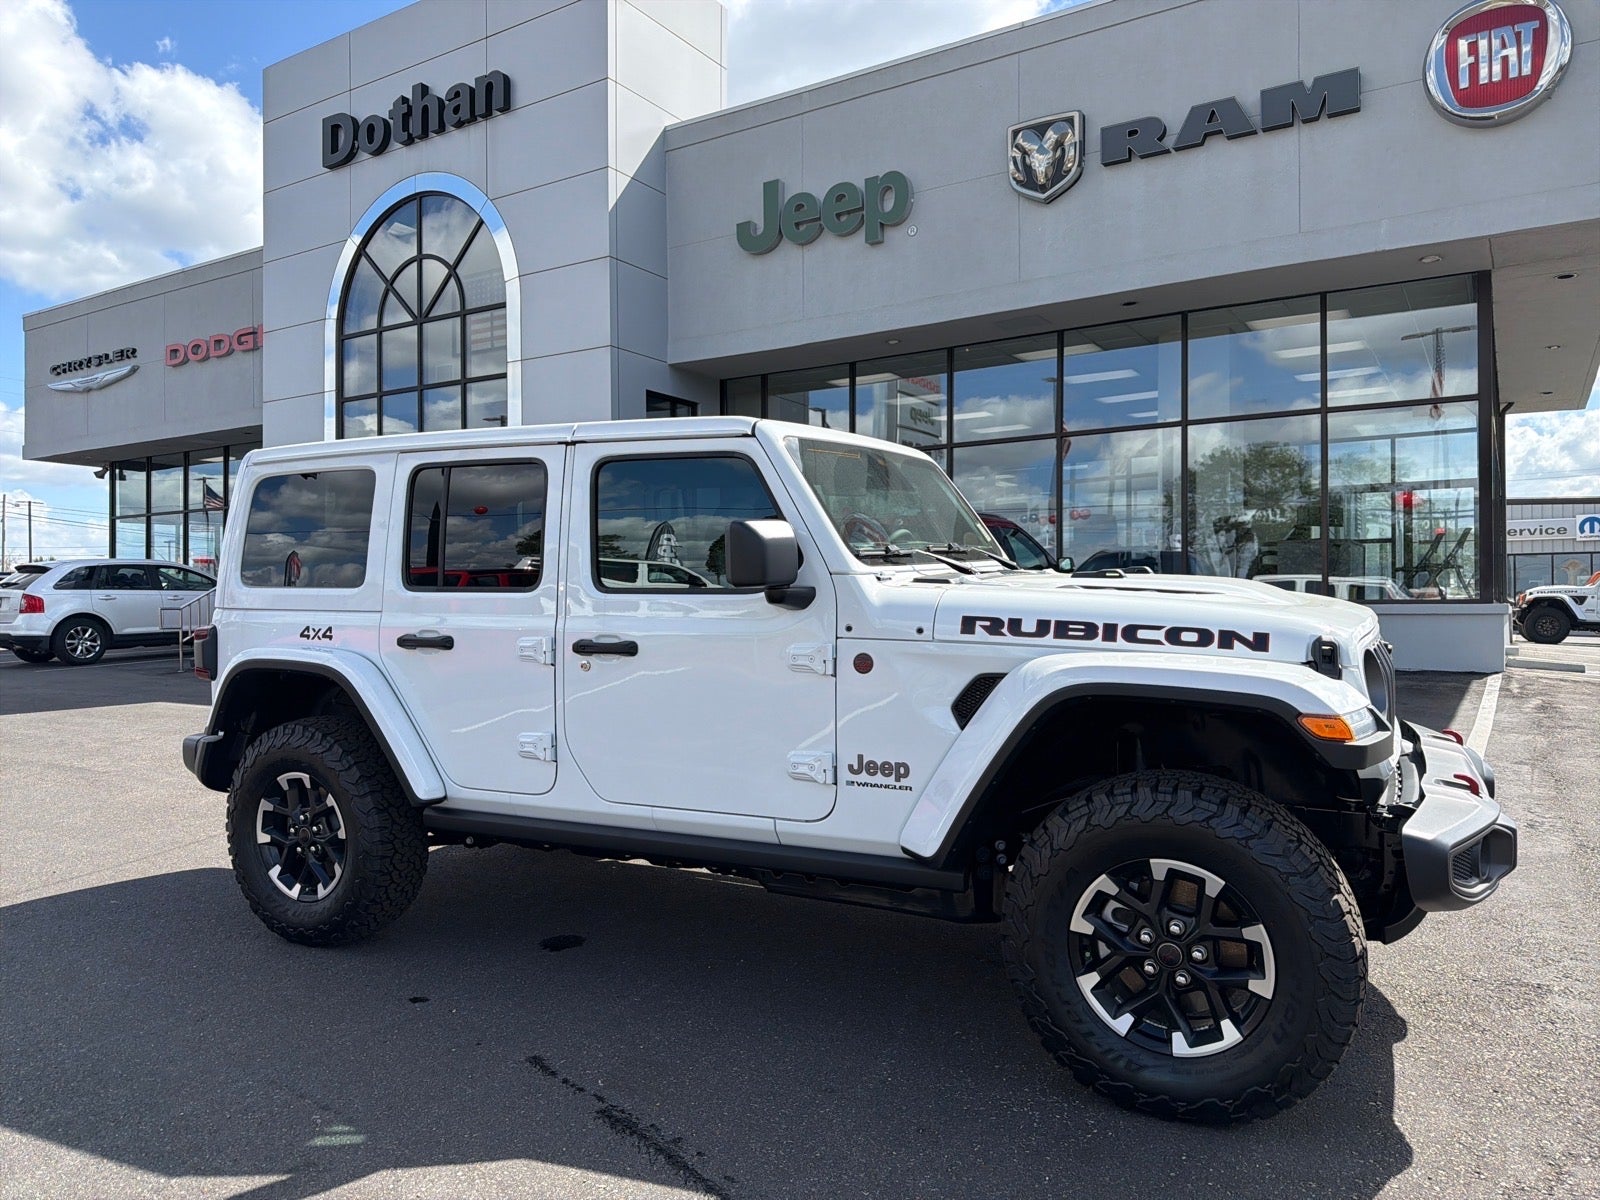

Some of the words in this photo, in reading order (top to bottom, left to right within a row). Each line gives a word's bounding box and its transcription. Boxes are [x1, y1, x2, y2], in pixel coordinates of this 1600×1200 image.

[1458, 20, 1540, 90] FIAT
[322, 70, 512, 169] Dothan
[1100, 66, 1361, 167] RAM
[736, 170, 914, 255] Jeep
[49, 347, 138, 376] CHRYSLER
[165, 324, 263, 367] DODG
[1507, 525, 1568, 537] ervice
[299, 625, 334, 641] 4x4
[959, 615, 1270, 653] RUBICON
[847, 753, 910, 783] Jeep
[856, 780, 913, 792] WRANGLER
